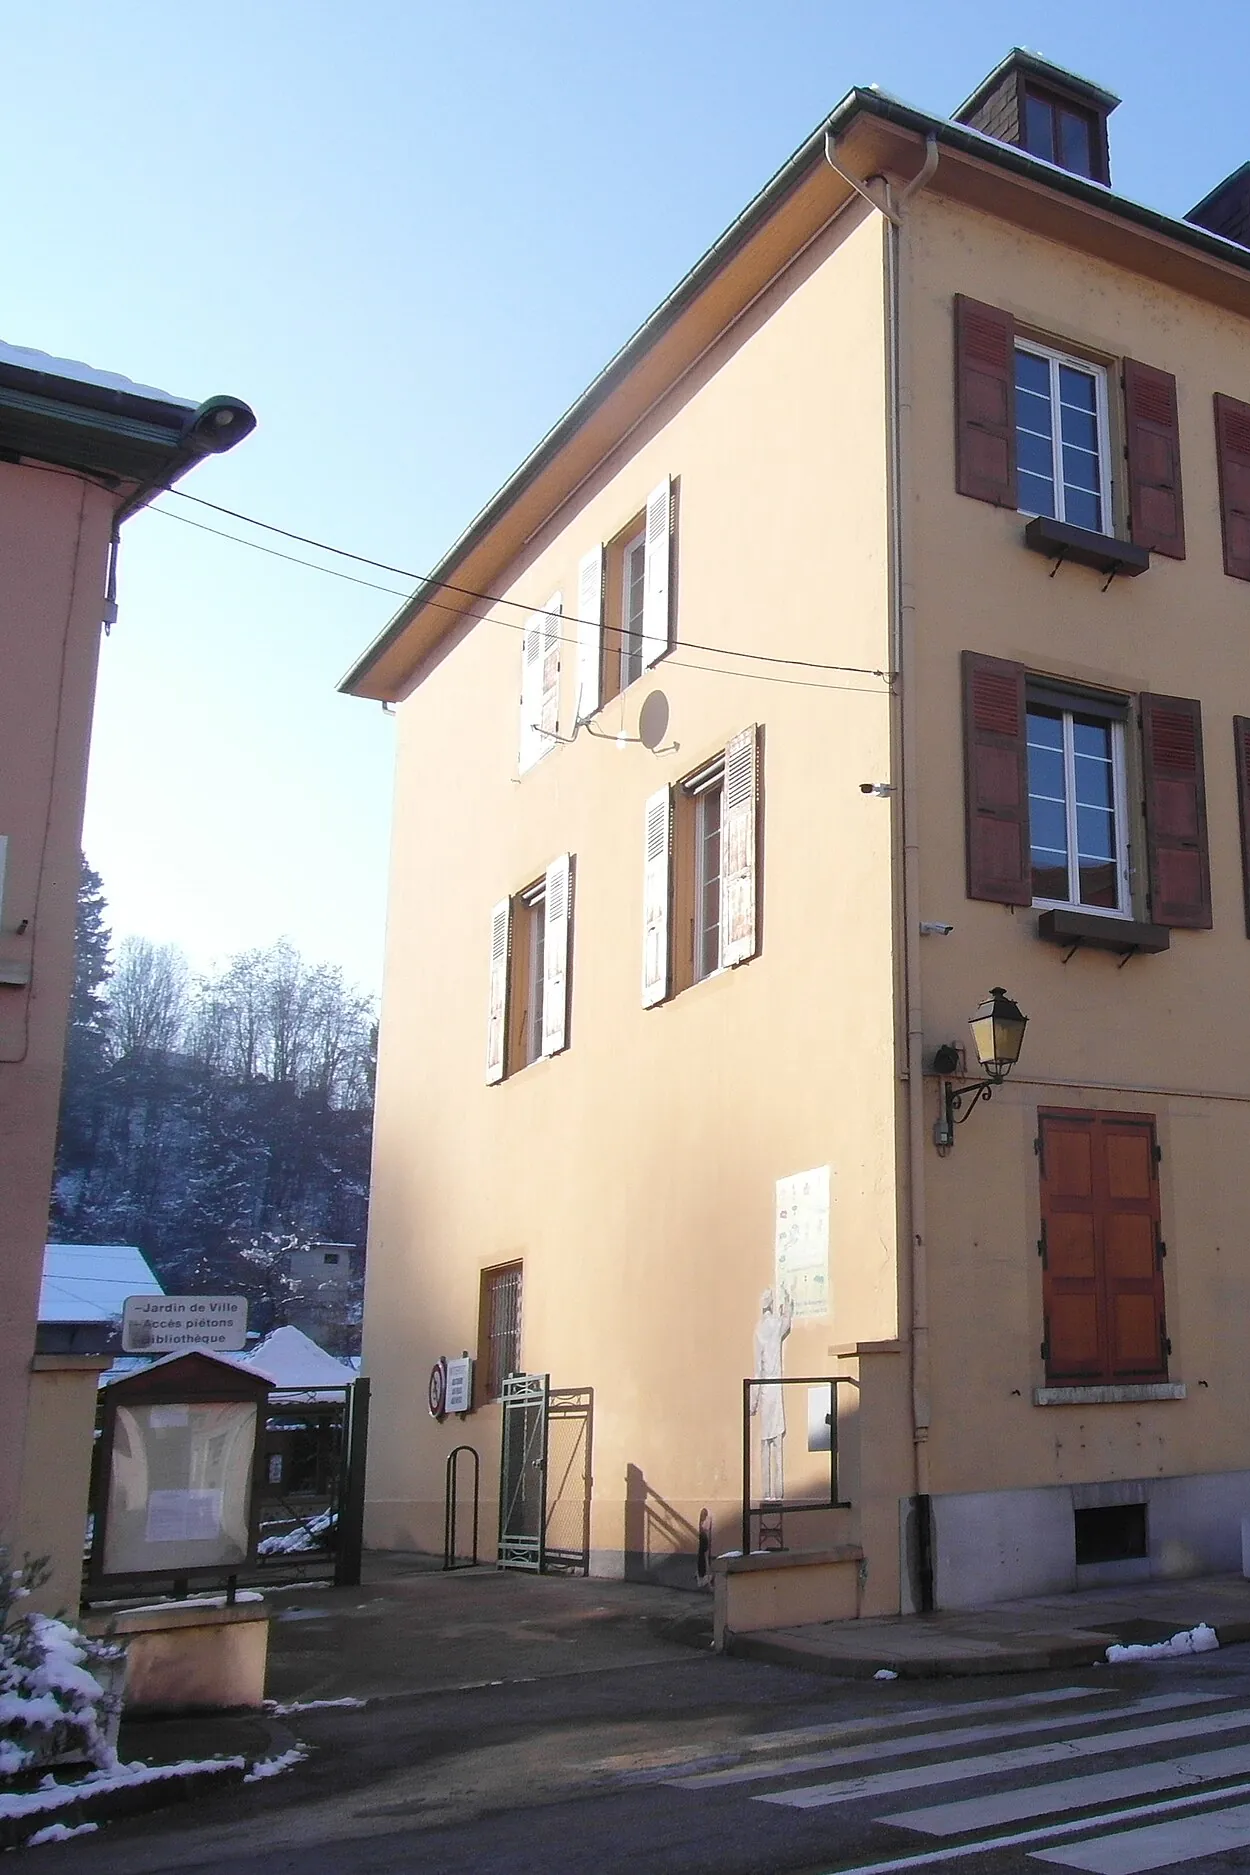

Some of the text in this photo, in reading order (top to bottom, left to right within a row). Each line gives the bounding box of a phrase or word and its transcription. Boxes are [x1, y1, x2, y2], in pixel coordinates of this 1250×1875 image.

[189, 1303, 206, 1312] de
[209, 1303, 238, 1312] Ville
[186, 1318, 234, 1329] piétons
